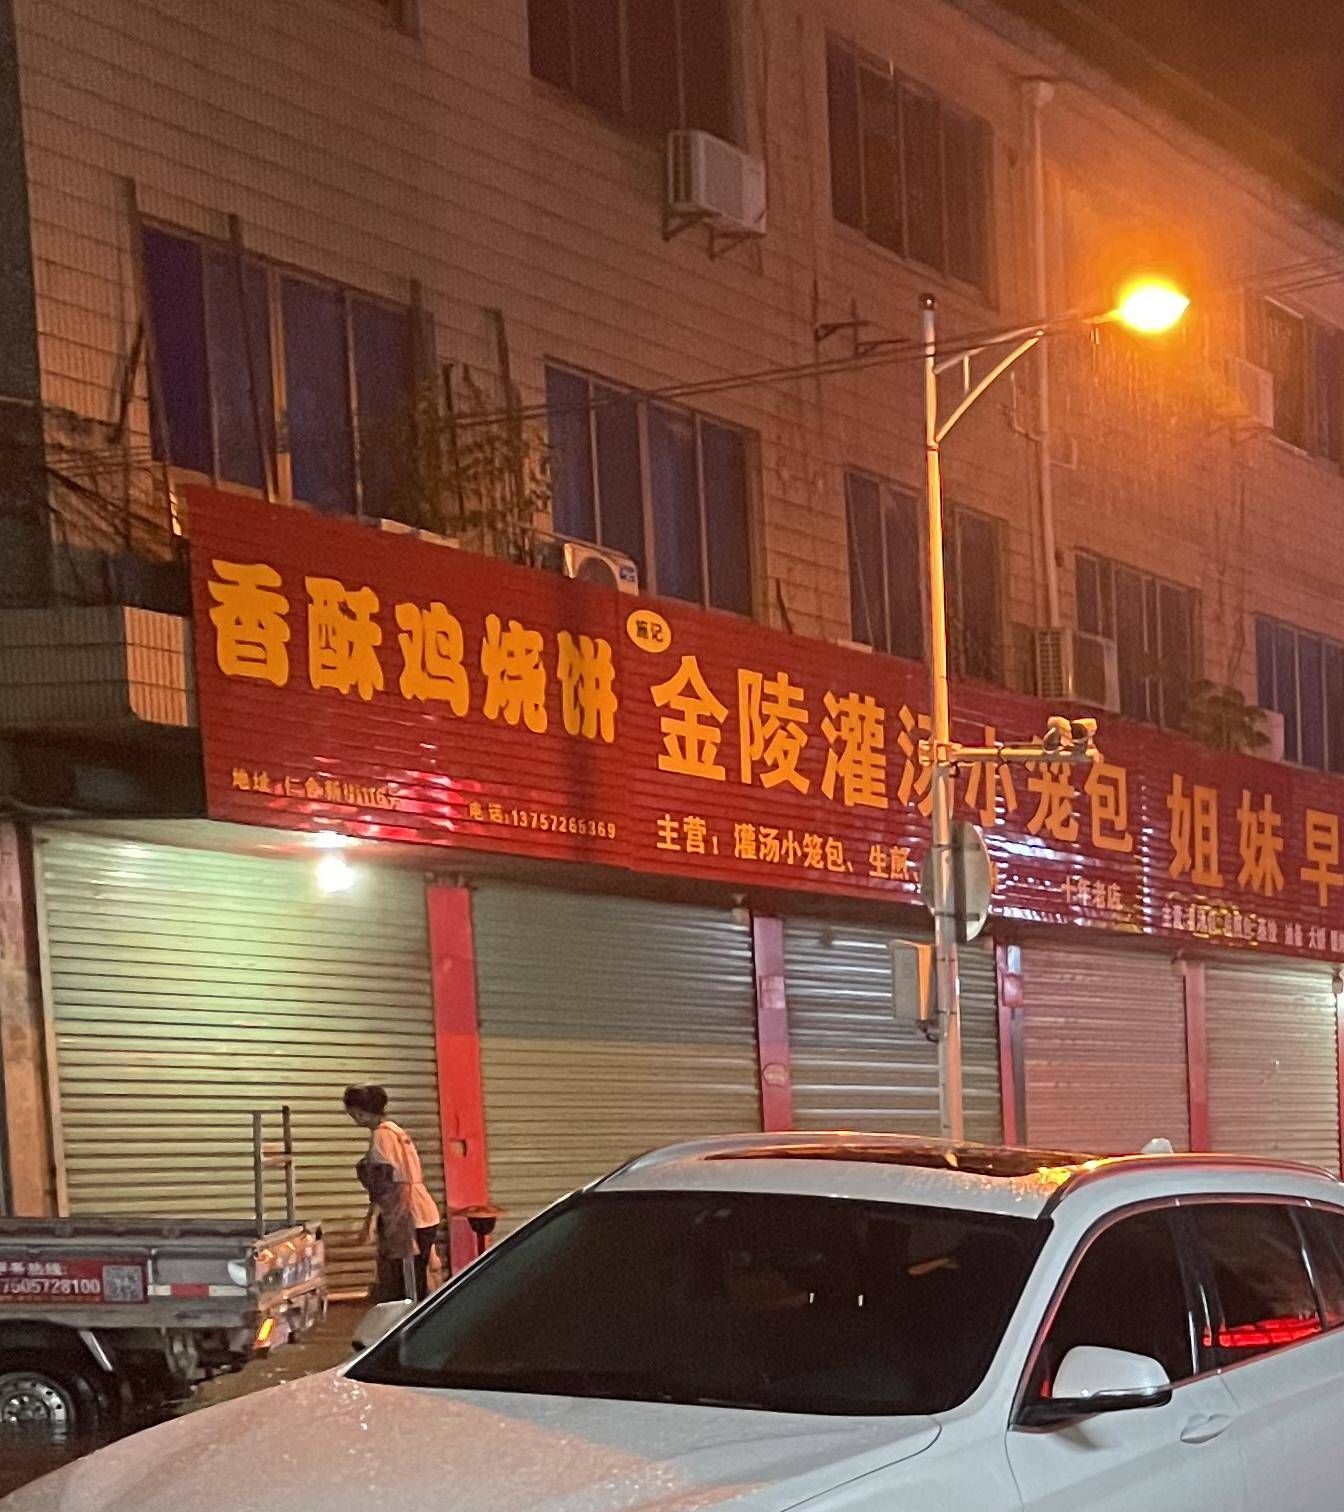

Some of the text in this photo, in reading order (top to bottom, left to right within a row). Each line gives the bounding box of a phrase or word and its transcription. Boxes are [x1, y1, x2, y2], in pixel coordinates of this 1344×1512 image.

[207, 559, 618, 743] 香酥鸡烧饼
[651, 655, 1133, 853] 金陵灌汤小笼包
[1062, 875, 1123, 909] 十年老店
